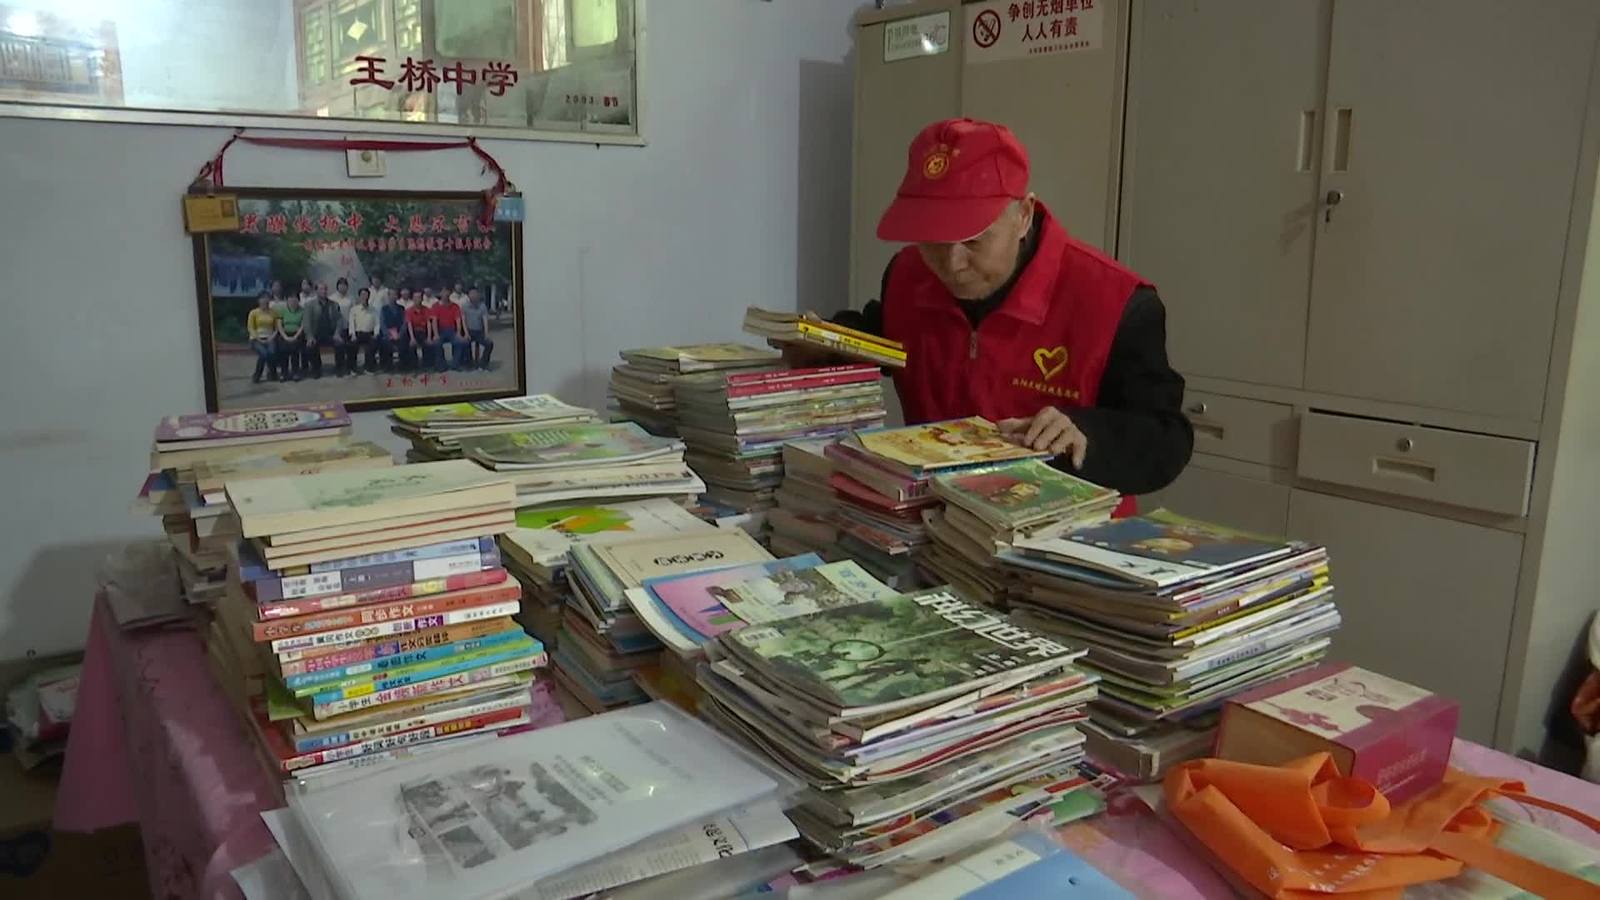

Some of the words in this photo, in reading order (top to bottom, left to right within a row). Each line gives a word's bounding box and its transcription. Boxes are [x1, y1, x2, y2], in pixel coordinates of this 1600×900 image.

[1008, 0, 1094, 22] 争创无烟单位
[1021, 16, 1078, 42] 人人有责
[350, 55, 519, 97] 王桥中学
